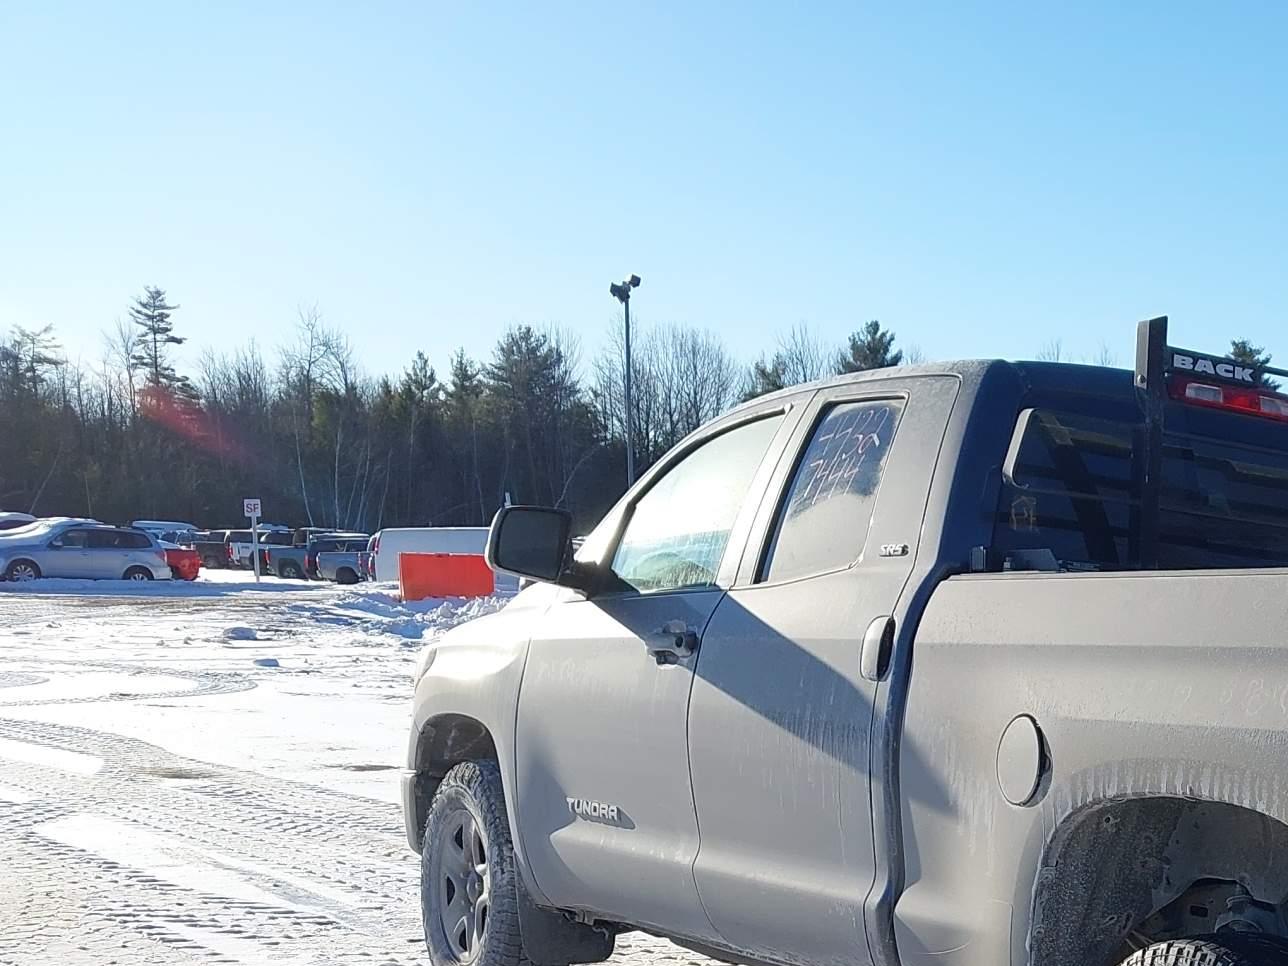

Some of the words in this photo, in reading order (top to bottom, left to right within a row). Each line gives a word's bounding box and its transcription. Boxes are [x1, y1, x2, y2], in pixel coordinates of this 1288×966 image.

[1173, 353, 1254, 382] BACK
[803, 454, 866, 505] 7444
[246, 503, 259, 513] SF
[566, 797, 618, 821] TUNDRA
